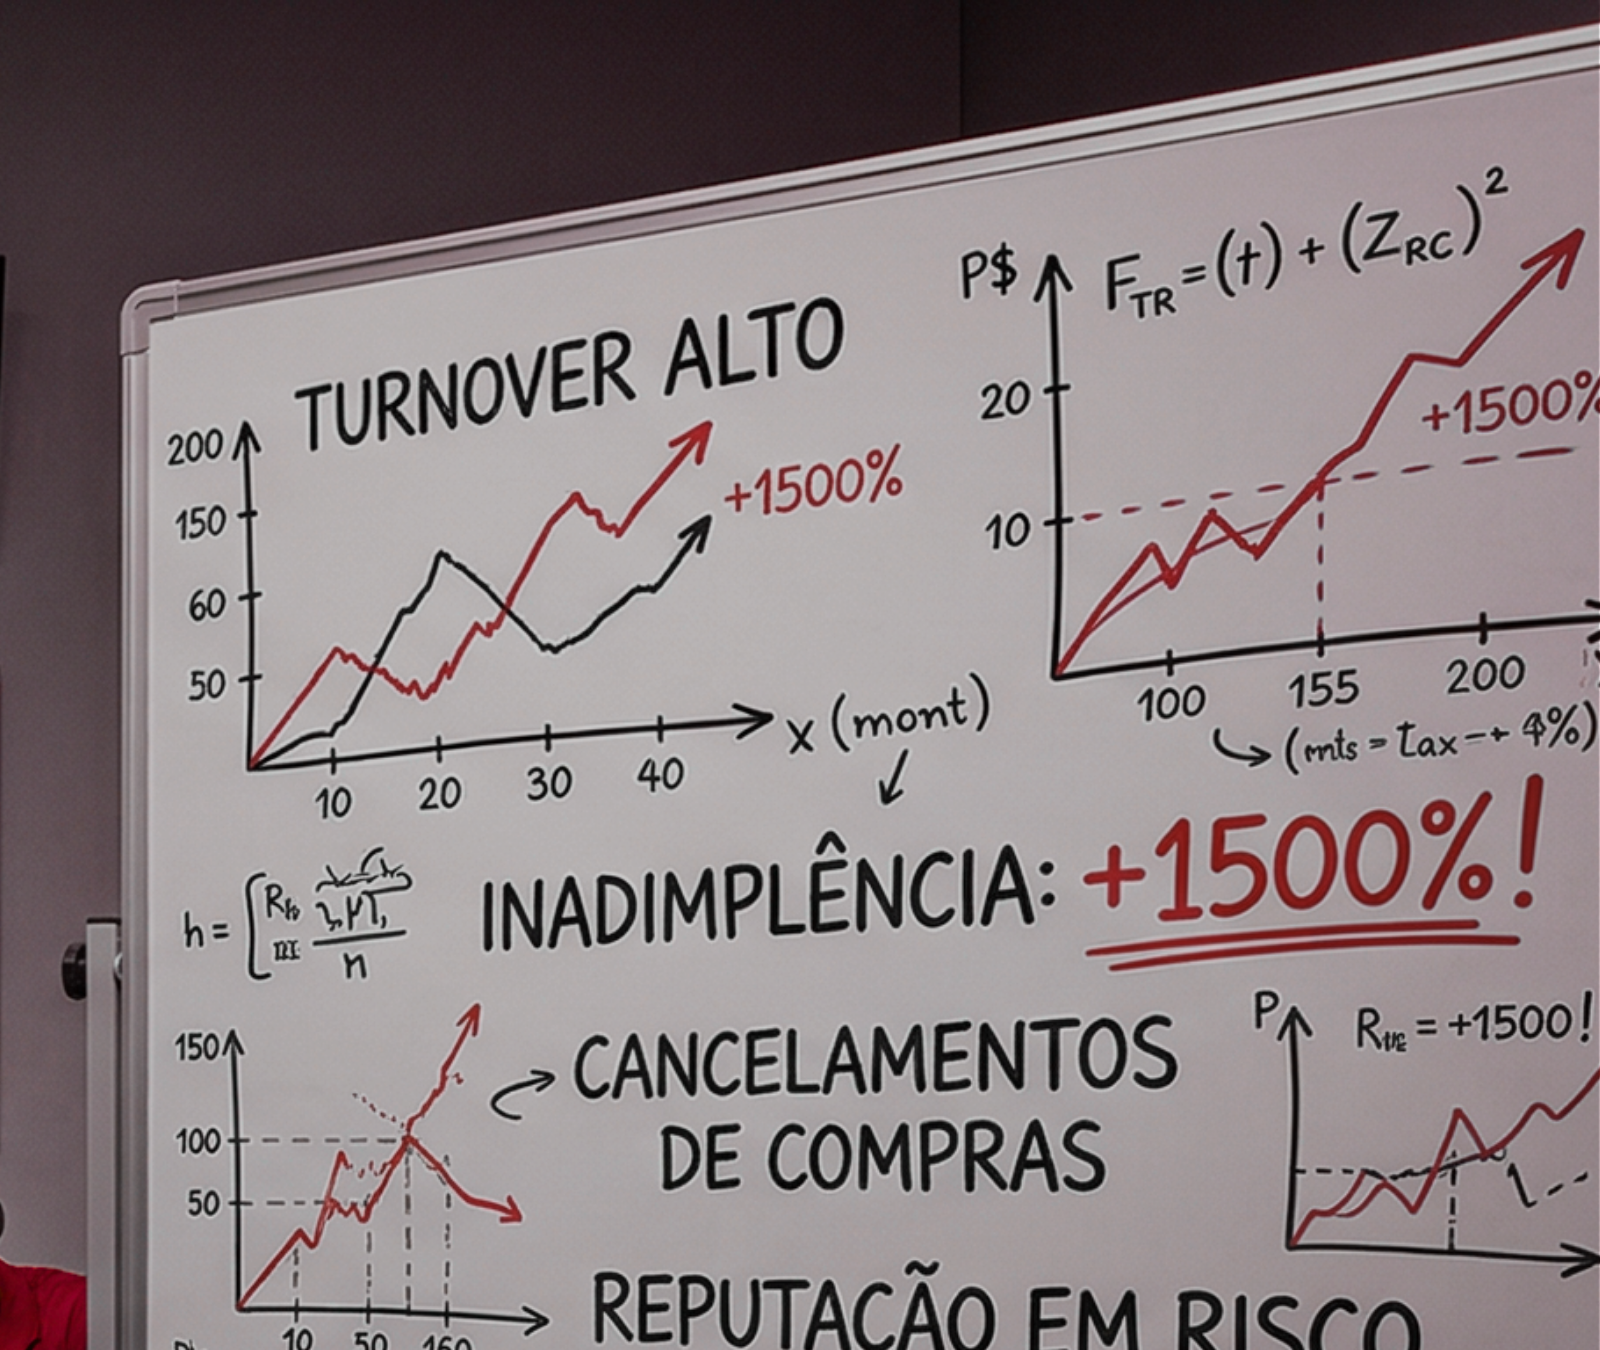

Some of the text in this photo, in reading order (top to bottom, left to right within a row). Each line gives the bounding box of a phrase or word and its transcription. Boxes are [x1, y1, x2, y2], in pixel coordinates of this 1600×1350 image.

[961, 242, 1018, 299] P$
[294, 296, 845, 452] TURNOVER ALTO
[981, 381, 1032, 420] 20
[167, 429, 225, 467] 200
[725, 443, 905, 516] +1500%
[175, 504, 227, 541] 150
[985, 513, 1032, 550] 10
[189, 588, 227, 621] 60
[189, 668, 226, 703] 50
[1138, 656, 1527, 722] 100 155 200
[315, 787, 353, 819] 10
[418, 776, 462, 811] 20
[525, 764, 574, 801] 30
[636, 757, 686, 792] 40
[482, 830, 1057, 954] INADIMPLÊNCIA:
[1082, 772, 1546, 922] +1500%!
[175, 1033, 221, 1063] 150
[574, 1012, 1179, 1101] CANCELAMENTOS
[175, 1127, 222, 1155] 100
[661, 1117, 1108, 1194] DE COMPRAS
[187, 1190, 220, 1218] 50
